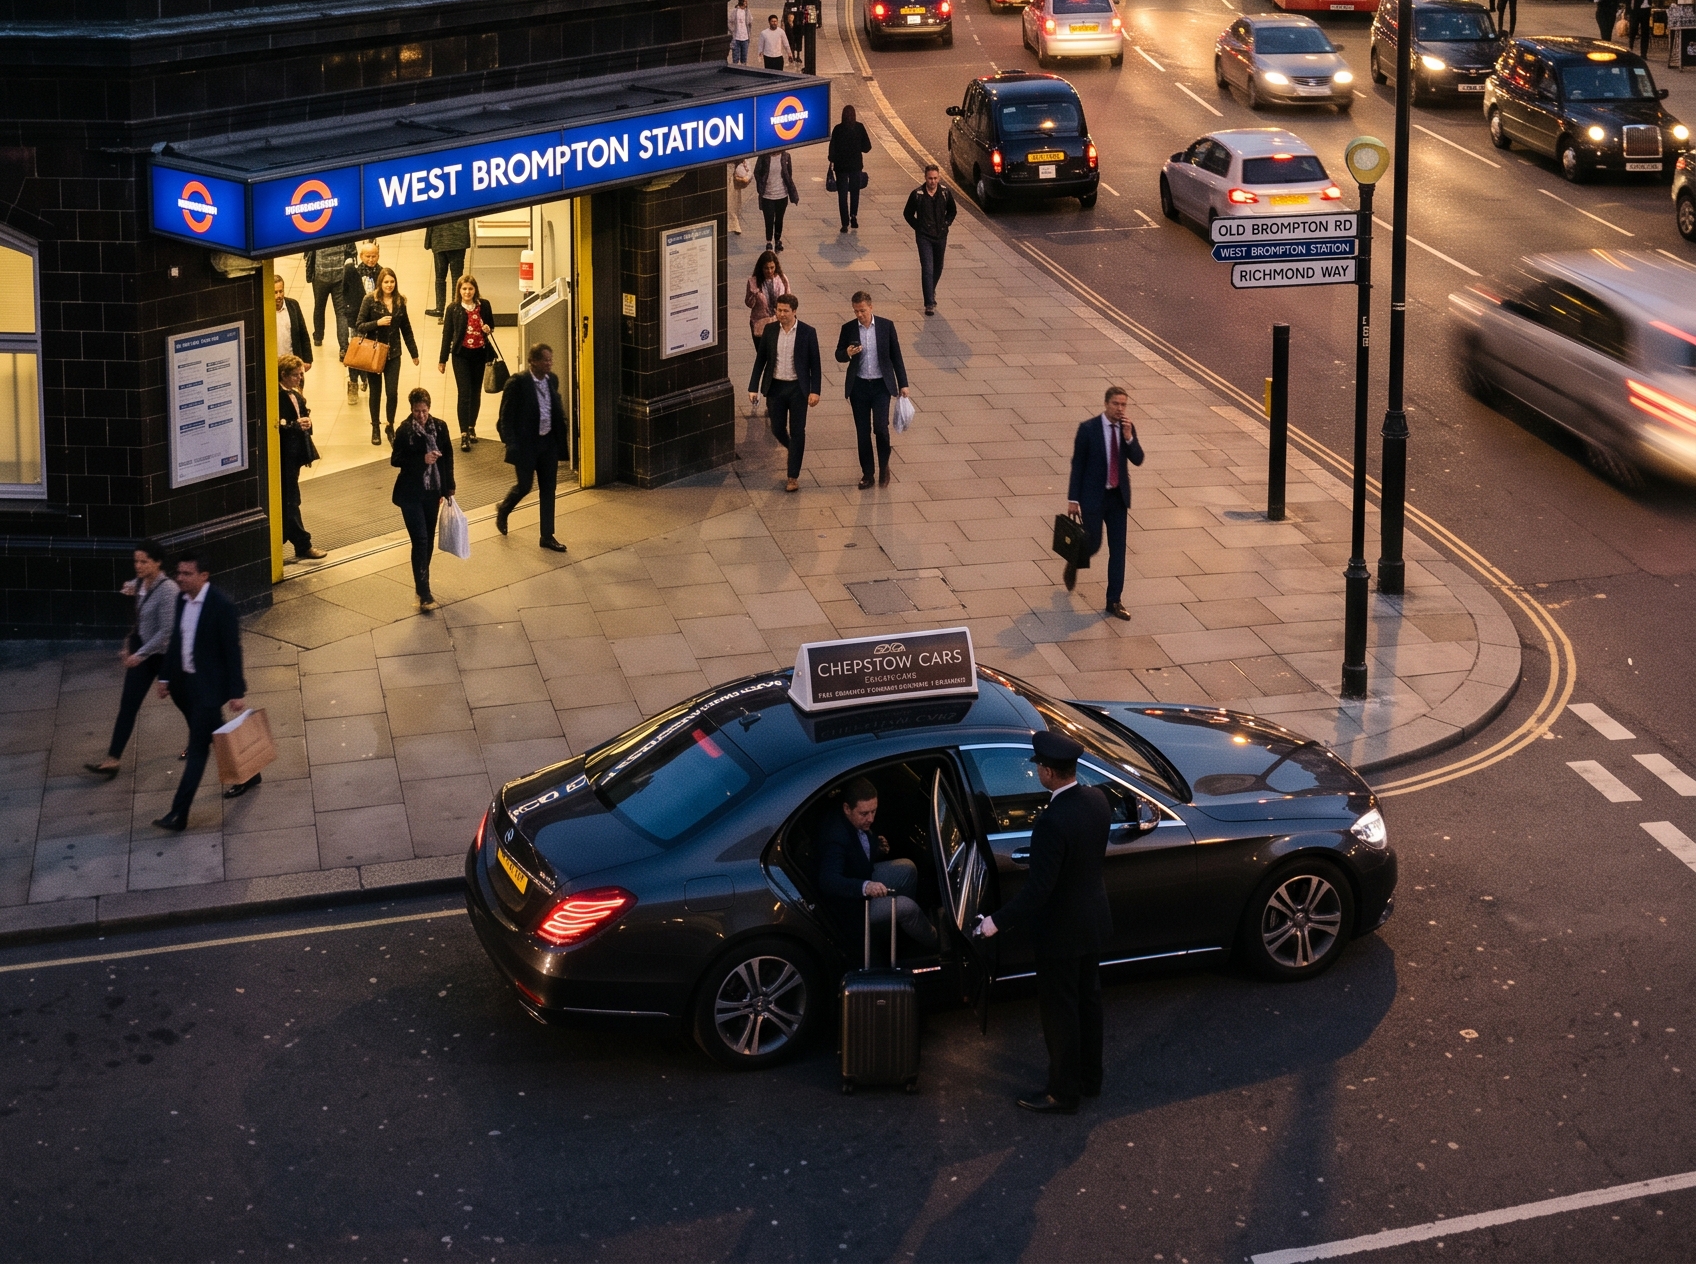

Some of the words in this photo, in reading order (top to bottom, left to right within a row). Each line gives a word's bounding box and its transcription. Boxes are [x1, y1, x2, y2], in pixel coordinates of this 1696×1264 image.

[378, 163, 463, 208] WEST
[472, 133, 629, 191] BROMPTON
[639, 112, 744, 160] STATION
[1218, 224, 1246, 237] OLD
[1251, 220, 1329, 236] BROMPTON
[1334, 219, 1353, 232] RD
[1220, 247, 1247, 258] WEST
[1251, 245, 1306, 256] BROMPTON
[1310, 243, 1350, 253] STATION
[1239, 267, 1315, 283] RICHMOND
[1320, 265, 1350, 279] WAY
[817, 654, 912, 677] CHEPSTOW
[918, 649, 962, 667] CARS
